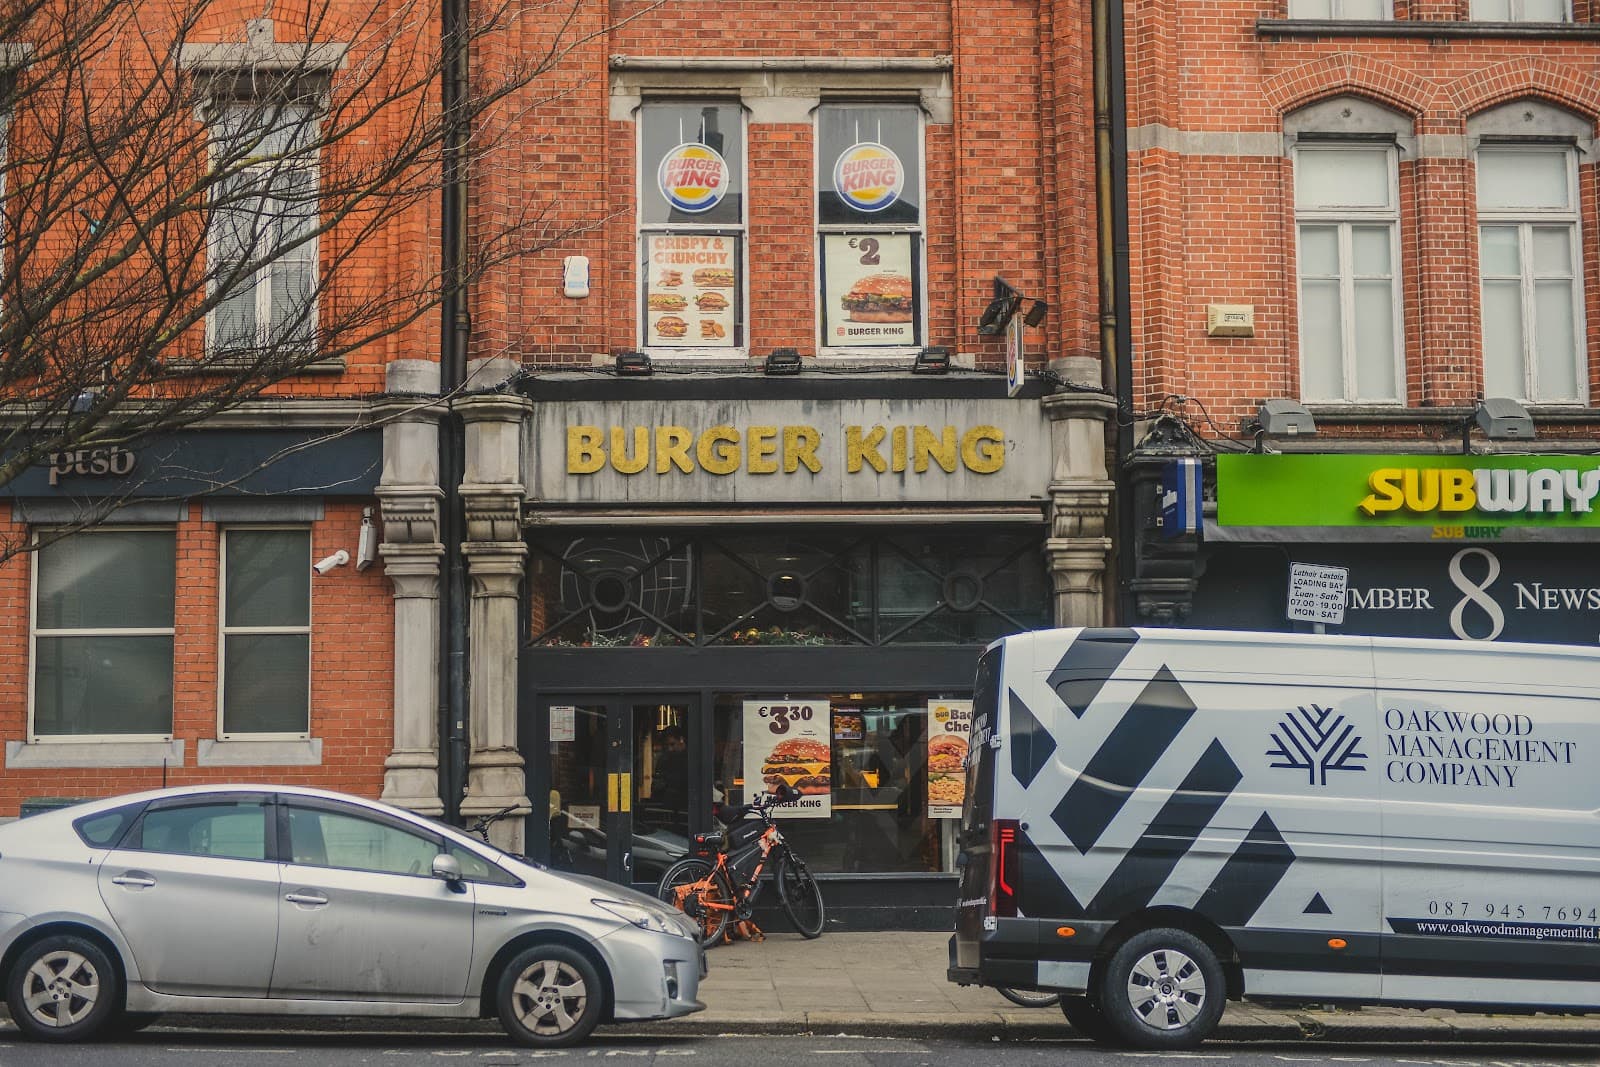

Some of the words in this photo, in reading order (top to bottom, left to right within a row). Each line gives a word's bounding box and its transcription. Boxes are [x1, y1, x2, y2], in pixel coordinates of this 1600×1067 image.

[667, 157, 722, 172] BURGER
[842, 158, 896, 176] BURGER
[664, 170, 721, 189] KING
[842, 170, 896, 193] KING
[654, 237, 710, 250] CRISPY
[713, 238, 724, 250] &
[654, 252, 728, 265] CRUNCHY
[848, 327, 881, 336] BURGER
[883, 327, 904, 335] KING
[567, 424, 823, 475] BURGER
[846, 424, 1006, 475] KING
[1360, 468, 1600, 515] SUBWAY
[1431, 525, 1503, 539] SUBWAY
[1293, 578, 1327, 588] LOADING
[1448, 547, 1505, 641] 8
[1294, 608, 1315, 617] MON
[1320, 610, 1338, 619] SAT
[1385, 708, 1533, 736] OAKWOOD
[1385, 733, 1577, 764] MANAGEMENT
[1386, 760, 1518, 788] COMPANY
[800, 800, 821, 808] KING
[1429, 900, 1469, 917] 087
[1486, 903, 1525, 919] 945
[1543, 906, 1598, 922] 7694
